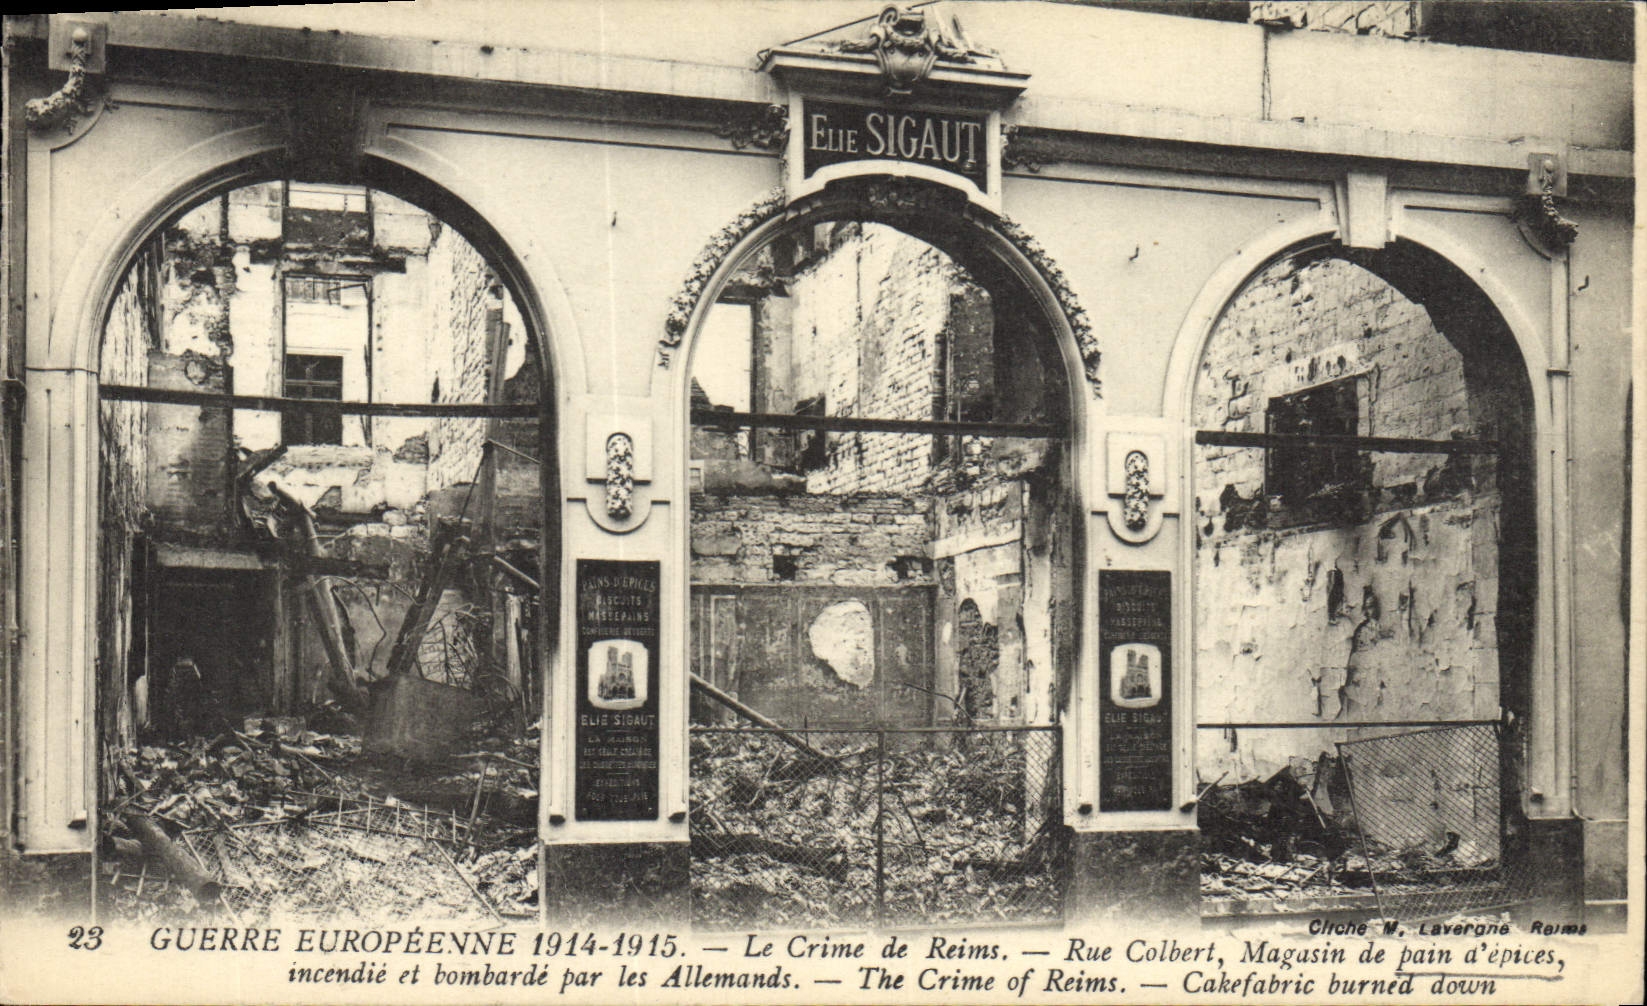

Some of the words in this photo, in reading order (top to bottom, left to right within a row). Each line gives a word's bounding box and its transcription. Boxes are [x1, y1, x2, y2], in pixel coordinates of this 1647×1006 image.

[865, 112, 981, 164] SIGAUT
[581, 713, 608, 726] ELIE
[614, 714, 655, 729] SIGAUT
[1104, 712, 1127, 723] ELIE
